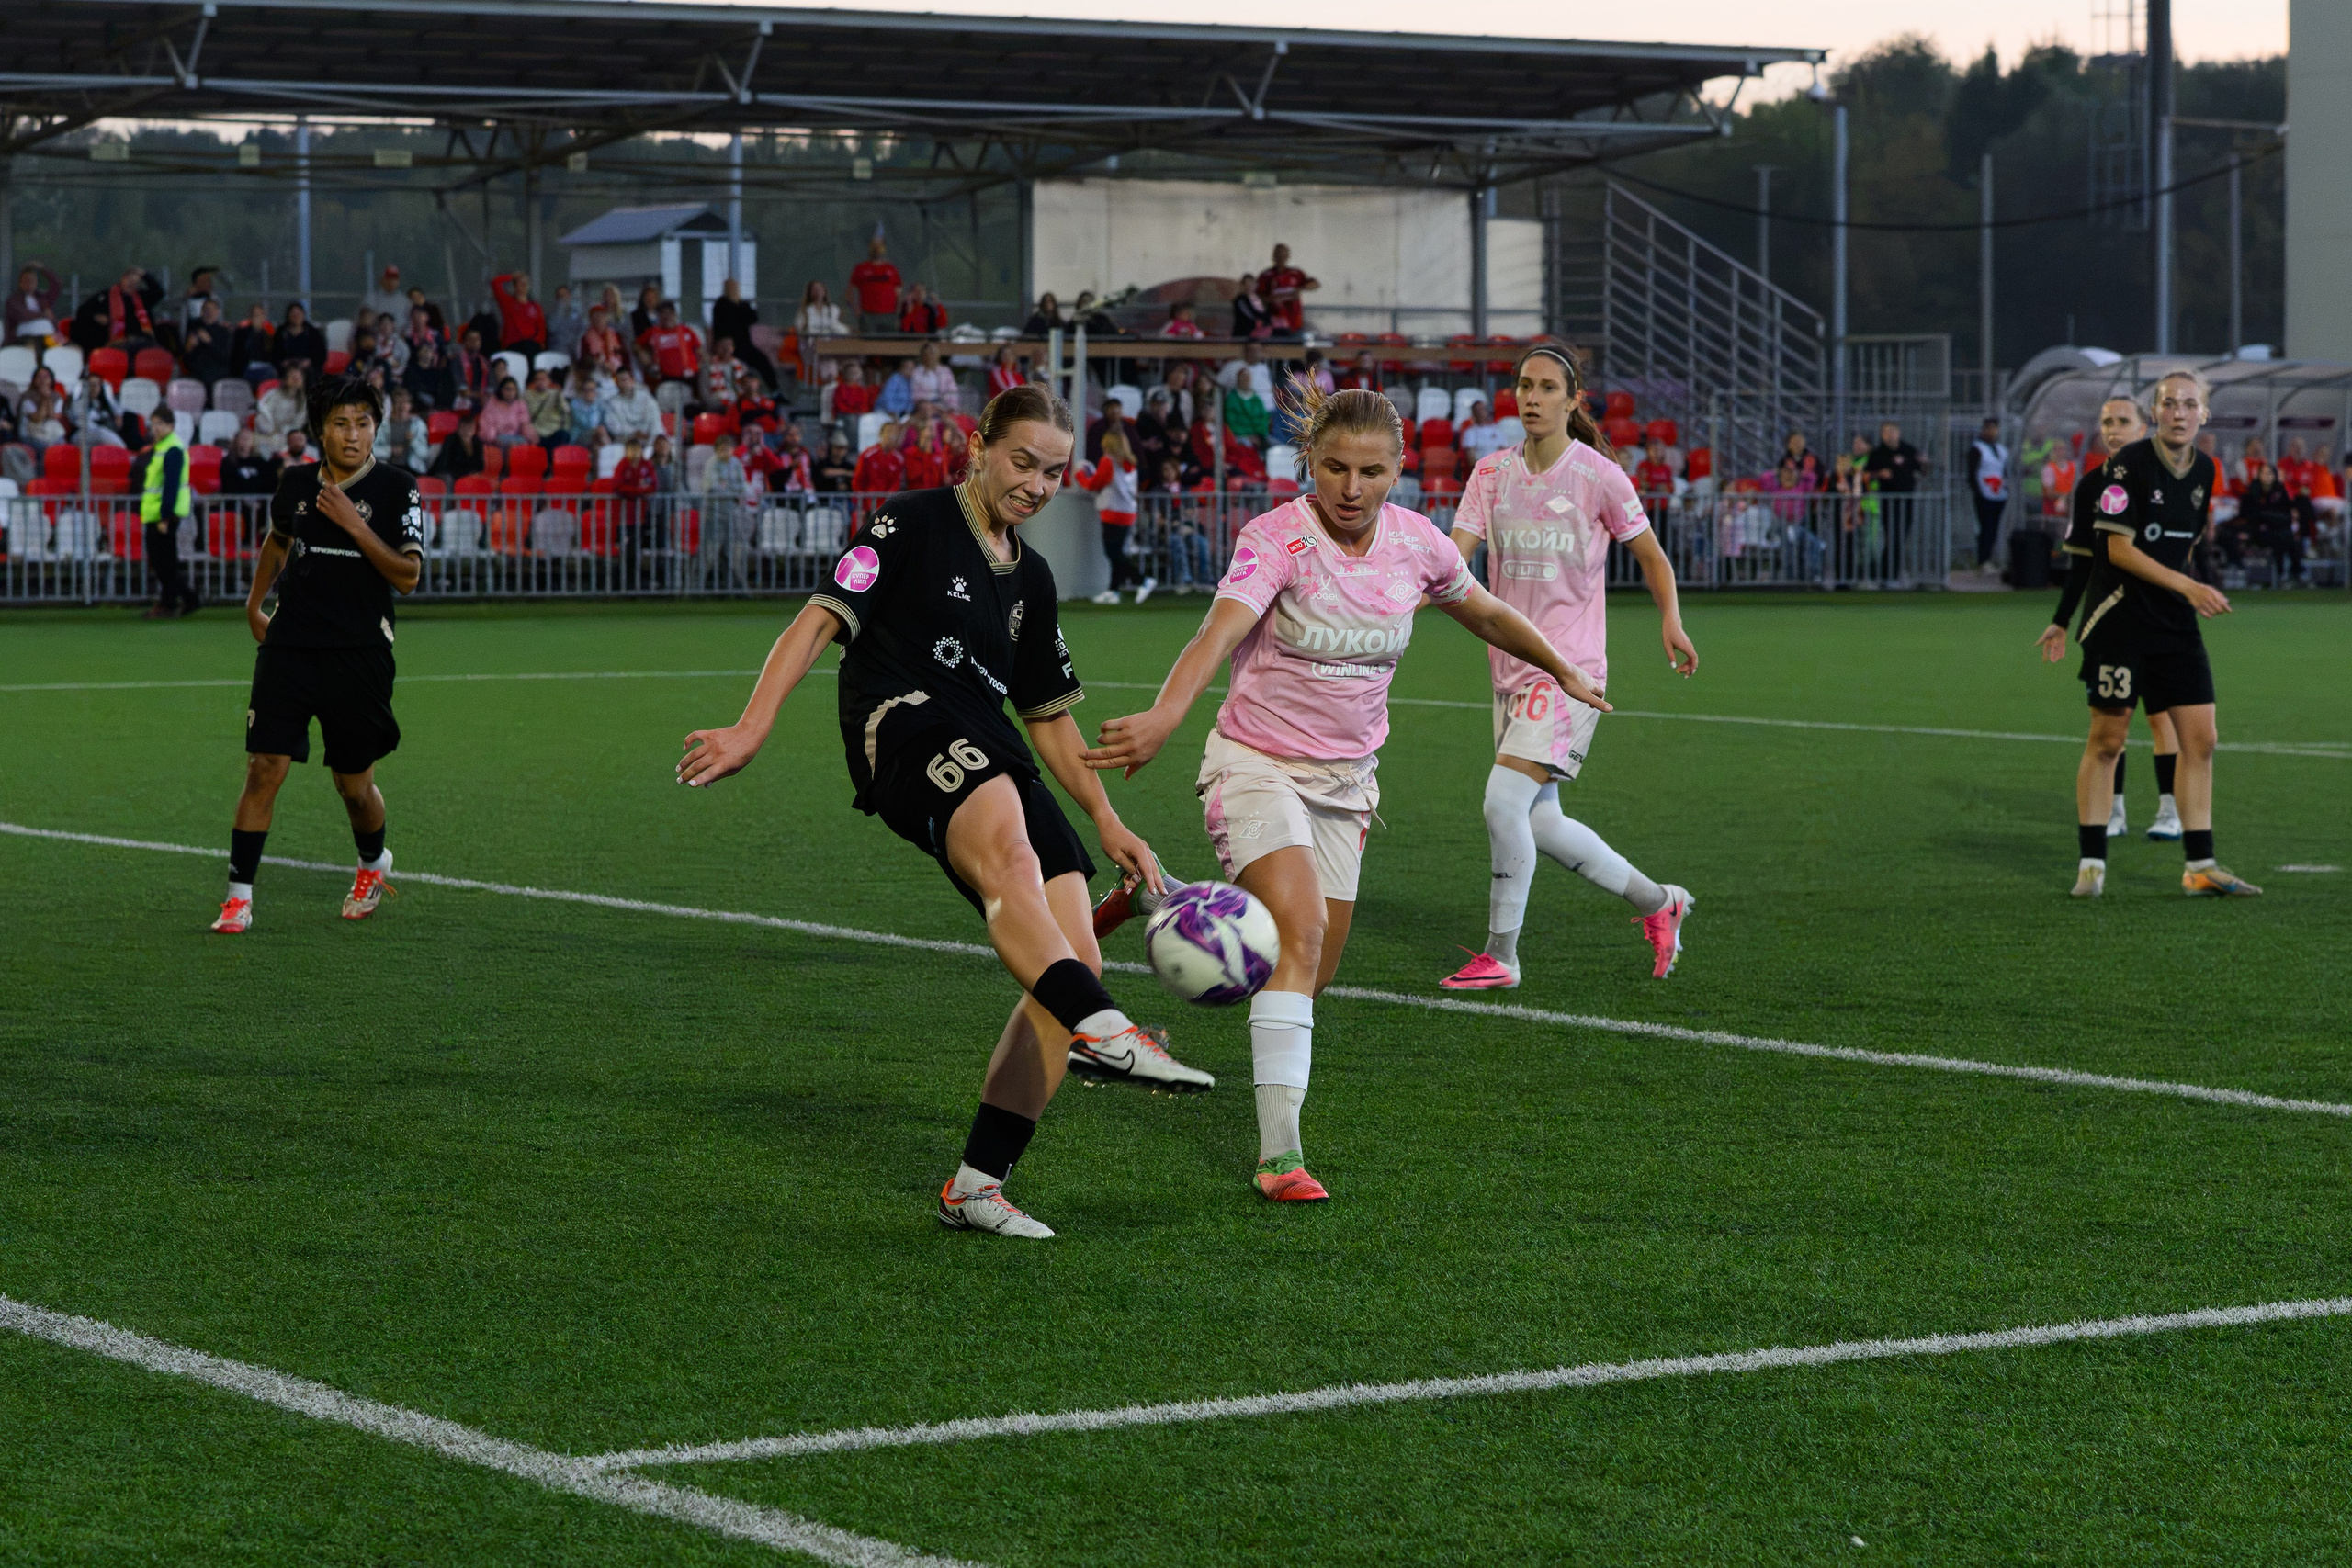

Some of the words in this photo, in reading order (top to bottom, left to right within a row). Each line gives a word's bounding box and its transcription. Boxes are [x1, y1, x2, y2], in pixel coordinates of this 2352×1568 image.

[1499, 527, 1576, 553] УКОЙЛ
[947, 590, 971, 602] KELME
[1320, 662, 1377, 677] WINLINE
[2098, 664, 2132, 699] 53
[926, 738, 989, 793] 66
